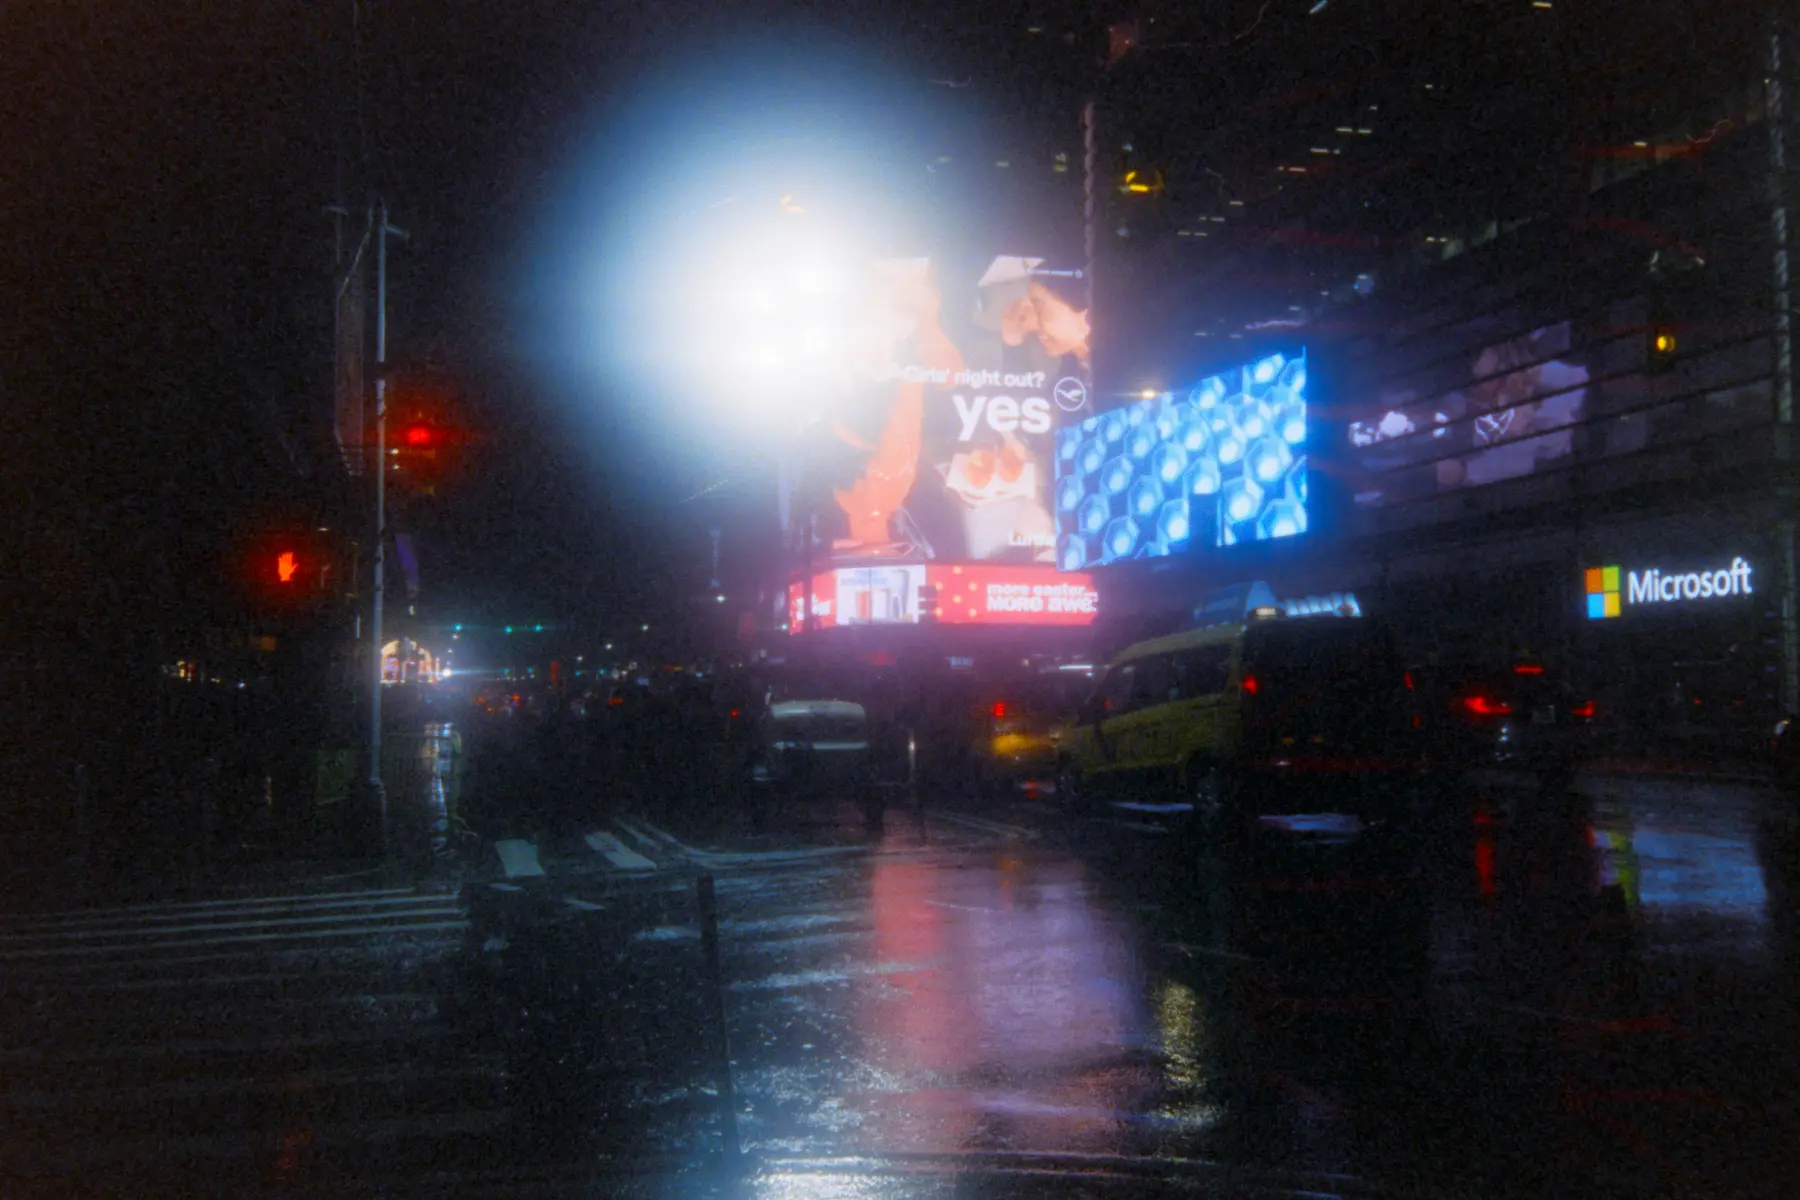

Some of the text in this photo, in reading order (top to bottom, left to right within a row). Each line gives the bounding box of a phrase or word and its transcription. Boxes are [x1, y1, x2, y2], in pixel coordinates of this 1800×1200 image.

[954, 368, 1001, 389] night
[1004, 371, 1045, 389] out?
[952, 394, 1050, 441] yes
[1628, 556, 1752, 604] Microsoft
